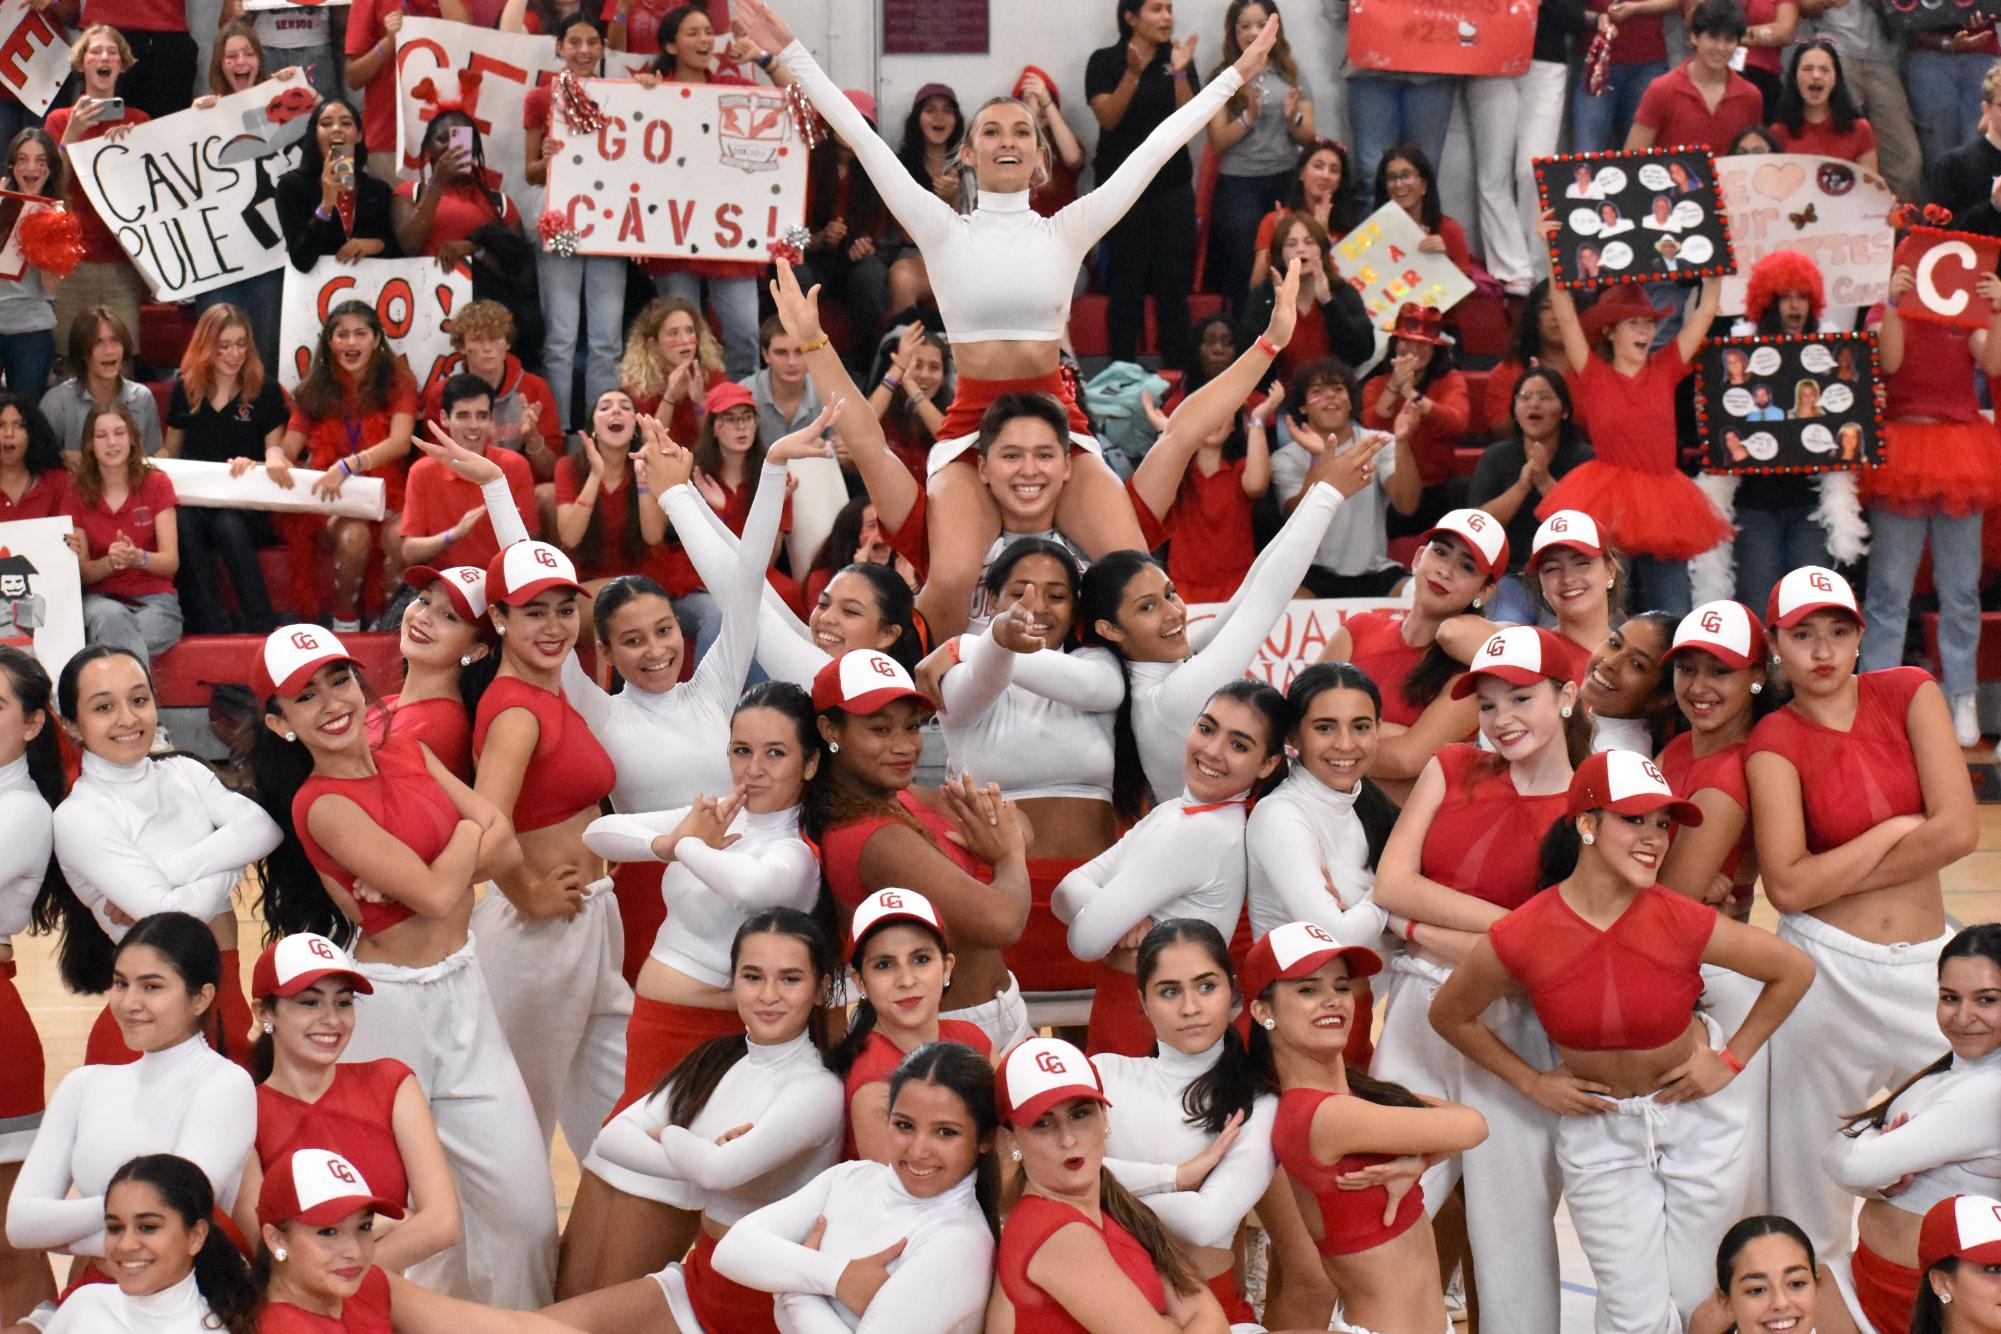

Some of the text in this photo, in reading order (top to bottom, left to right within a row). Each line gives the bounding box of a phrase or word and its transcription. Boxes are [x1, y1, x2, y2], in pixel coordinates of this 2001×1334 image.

[597, 115, 672, 164] GO
[93, 135, 239, 223] CAVS
[566, 193, 778, 253] CAVS!
[1387, 244, 1406, 263] A
[1916, 240, 1977, 316] C
[1468, 514, 1487, 532] CG
[1549, 517, 1569, 533] CG
[533, 547, 563, 569] CG
[457, 567, 480, 585] CG
[1808, 571, 1834, 592] CG
[1700, 610, 1722, 634] CG
[290, 631, 320, 651] CG
[1484, 632, 1505, 657] CG
[870, 656, 897, 678] CG
[1640, 760, 1663, 785] CG
[879, 892, 904, 910] CG
[1304, 924, 1334, 943] CG
[308, 938, 335, 960] CG
[1035, 1051, 1068, 1075] CG
[326, 1158, 358, 1184] CG
